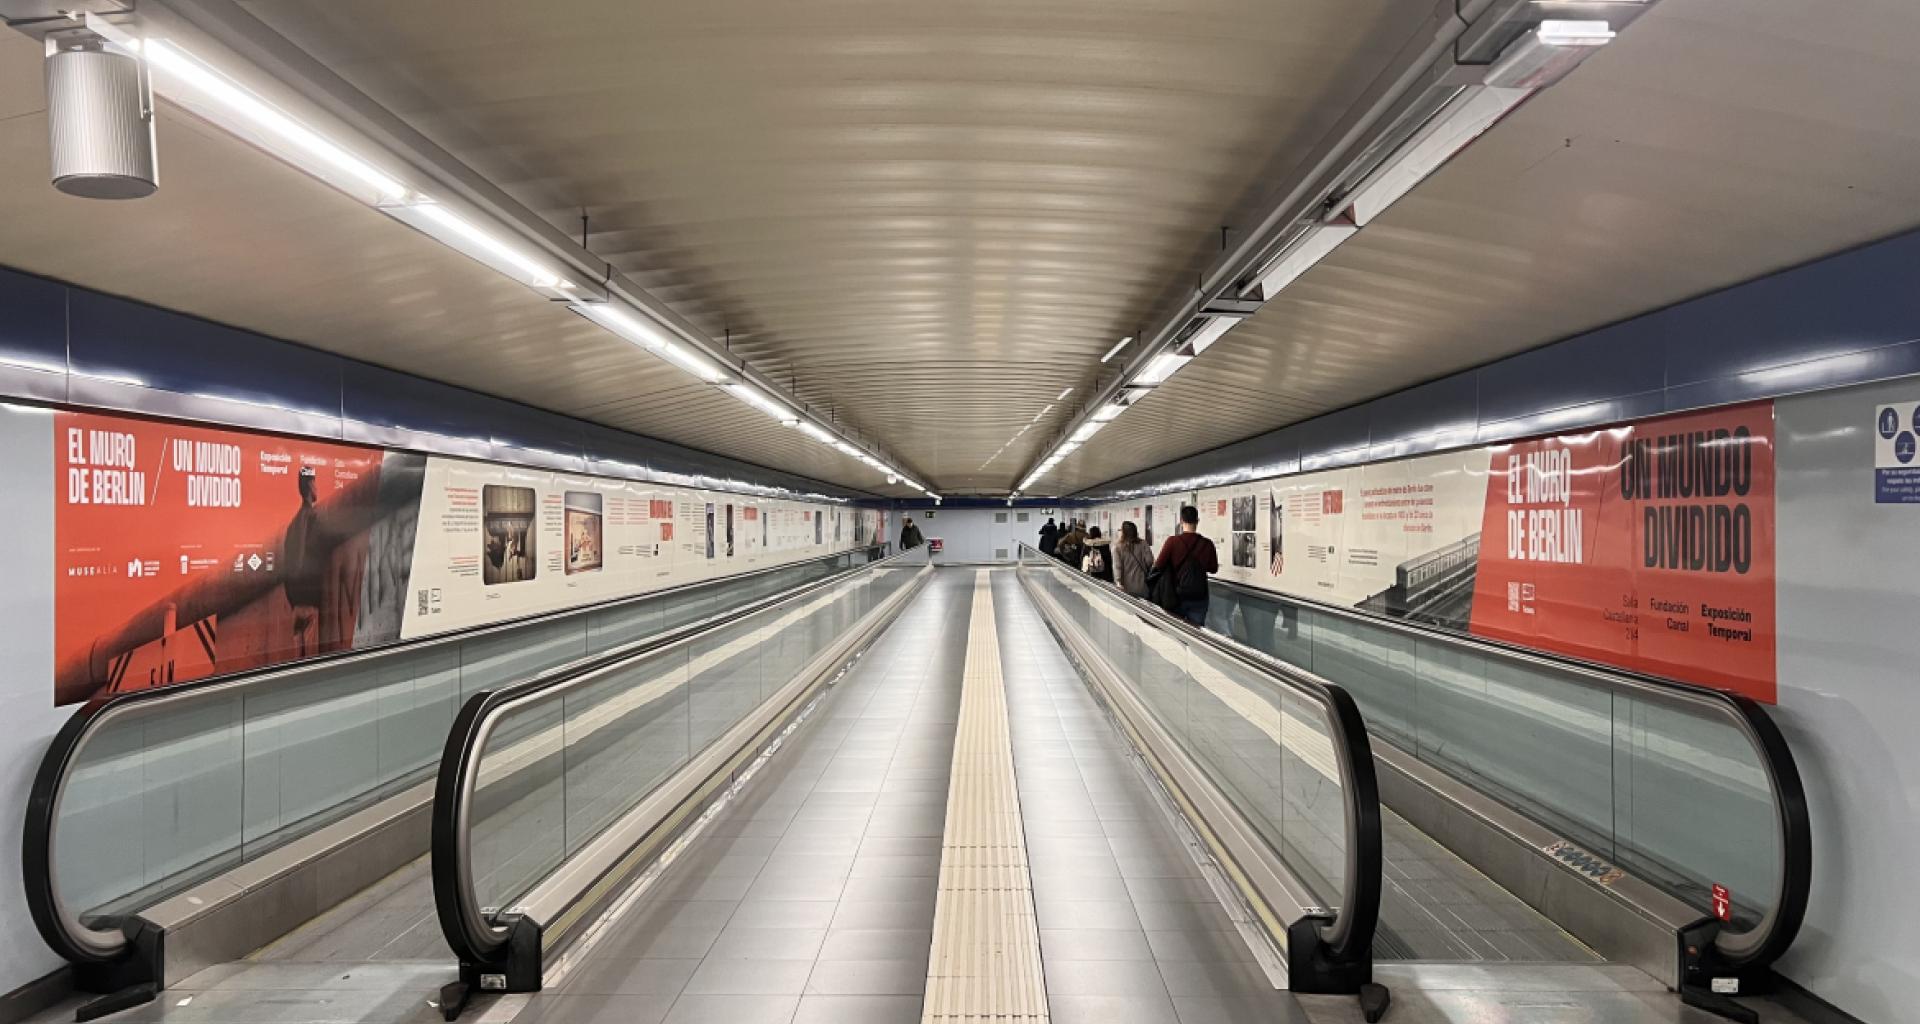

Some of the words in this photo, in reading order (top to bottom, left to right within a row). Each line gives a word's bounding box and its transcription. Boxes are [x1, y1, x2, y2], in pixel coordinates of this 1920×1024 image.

[68, 428, 86, 464] EL
[173, 439, 192, 472] UN
[196, 441, 241, 475] MUNDO
[1621, 439, 1650, 500] UN
[1657, 426, 1750, 498] MUNDO
[69, 468, 89, 504] DE
[187, 475, 241, 507] DIVIDIDO
[1508, 453, 1523, 504] EL
[1508, 510, 1525, 559] DE
[1644, 503, 1750, 574] DIVIDIDO
[1650, 597, 1689, 615] Fundación
[1701, 604, 1752, 623] Exposición
[1667, 617, 1689, 632] Canal
[1707, 622, 1752, 641] Temporal
